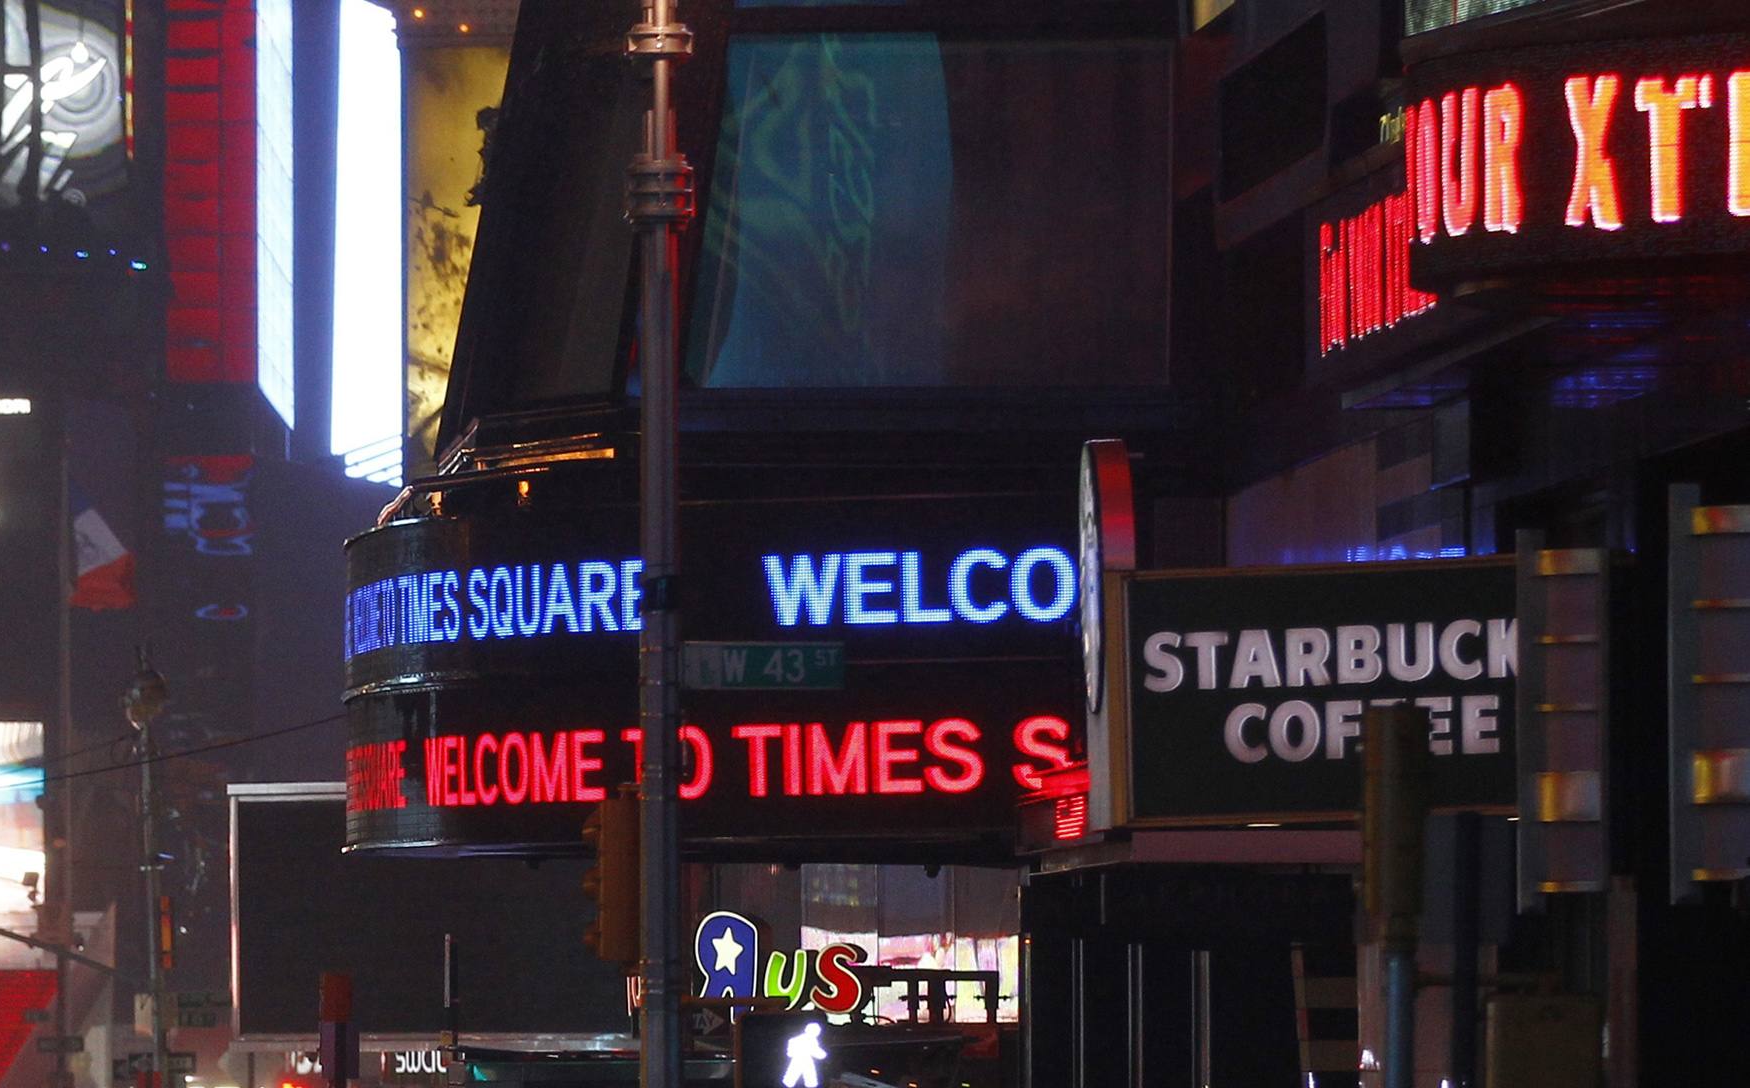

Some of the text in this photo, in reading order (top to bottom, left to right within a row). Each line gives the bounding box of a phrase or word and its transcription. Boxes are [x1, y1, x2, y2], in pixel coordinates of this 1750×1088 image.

[397, 570, 461, 643] TIMES
[467, 559, 644, 640] SQUARE
[761, 546, 1077, 626] WELCO
[722, 649, 838, 683] W 43 ST
[424, 729, 606, 806] WELCOME
[732, 717, 985, 799] TIMES
[1224, 694, 1500, 763] COFEE
